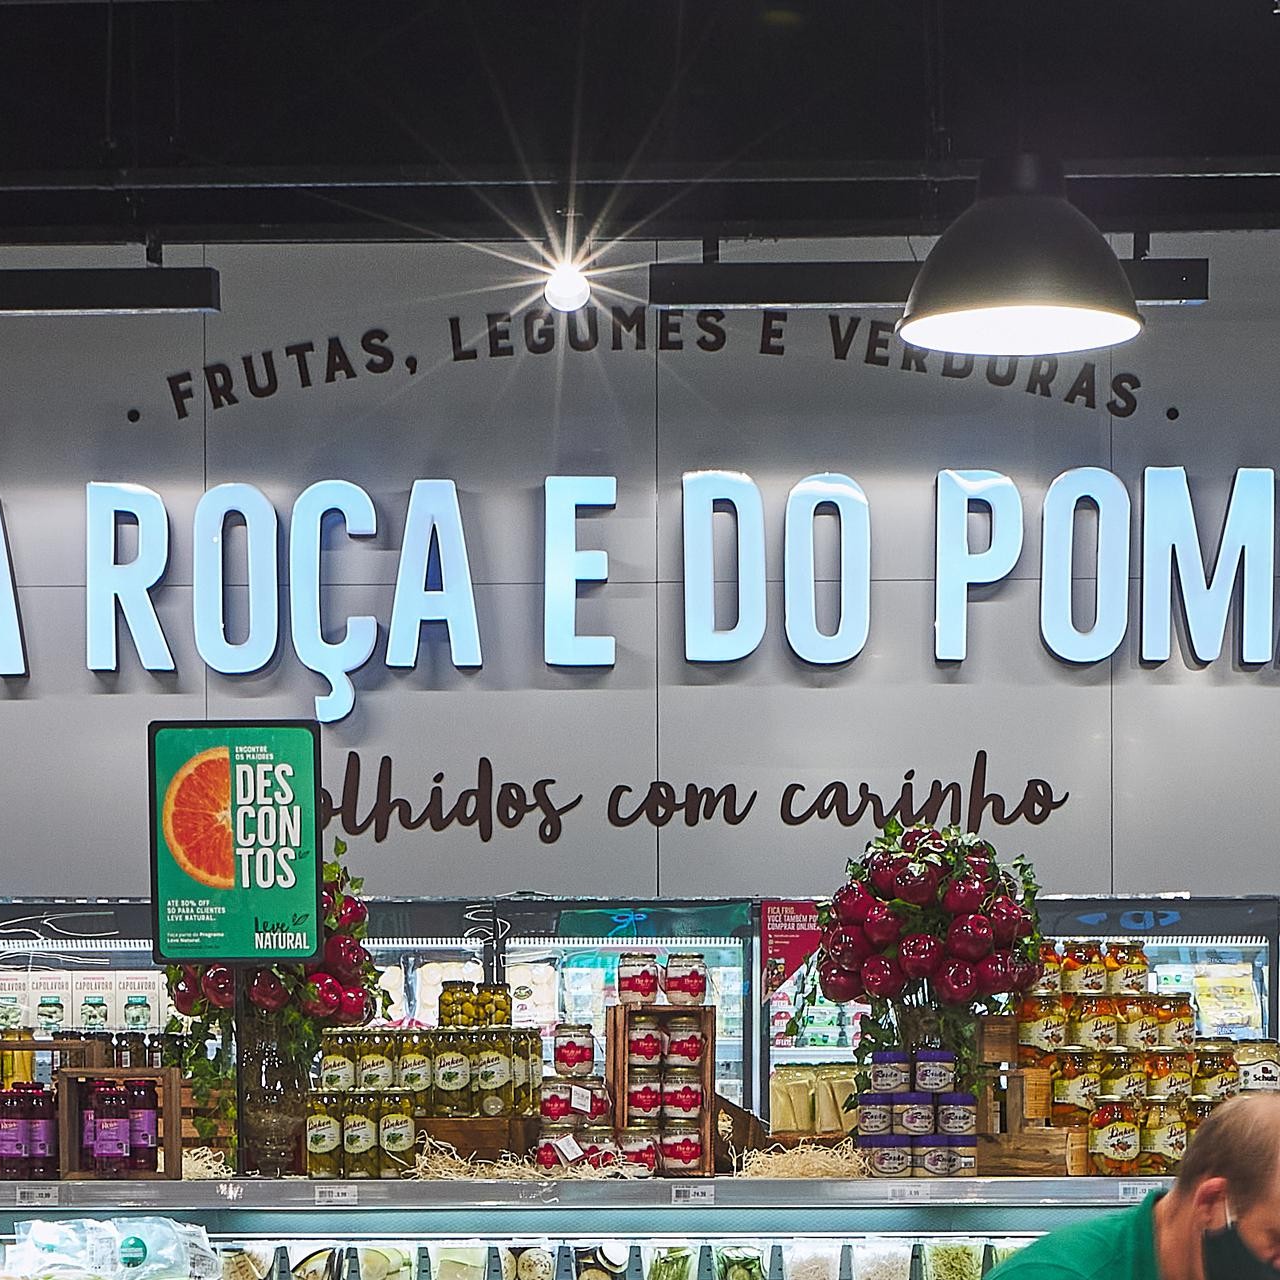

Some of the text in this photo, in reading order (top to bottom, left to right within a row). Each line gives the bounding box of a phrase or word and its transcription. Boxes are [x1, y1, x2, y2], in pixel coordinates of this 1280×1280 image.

[167, 328, 419, 421] FRUTAS,
[449, 307, 728, 363] LEGUMES
[758, 308, 786, 356] E
[86, 479, 484, 722] ROÇA
[544, 475, 618, 667] E
[683, 470, 871, 665] DO
[236, 763, 294, 805] DES
[607, 779, 757, 828] com
[780, 749, 1069, 834] carinho
[236, 806, 301, 847] CON
[236, 847, 296, 889] TOS
[178, 906, 226, 914] PARA CLIENTES
[768, 906, 780, 915] FICA
[167, 914, 179, 922] LEVE
[254, 915, 290, 934] Leve
[768, 914, 808, 923] VOCÊ TAMBÉM
[768, 923, 795, 931] COMPRAR
[254, 932, 310, 950] NATURAL
[32, 983, 70, 991] CAPOLAVORO
[75, 983, 113, 991] CAPOLAVORO
[118, 983, 156, 991] CAPOLAVORO
